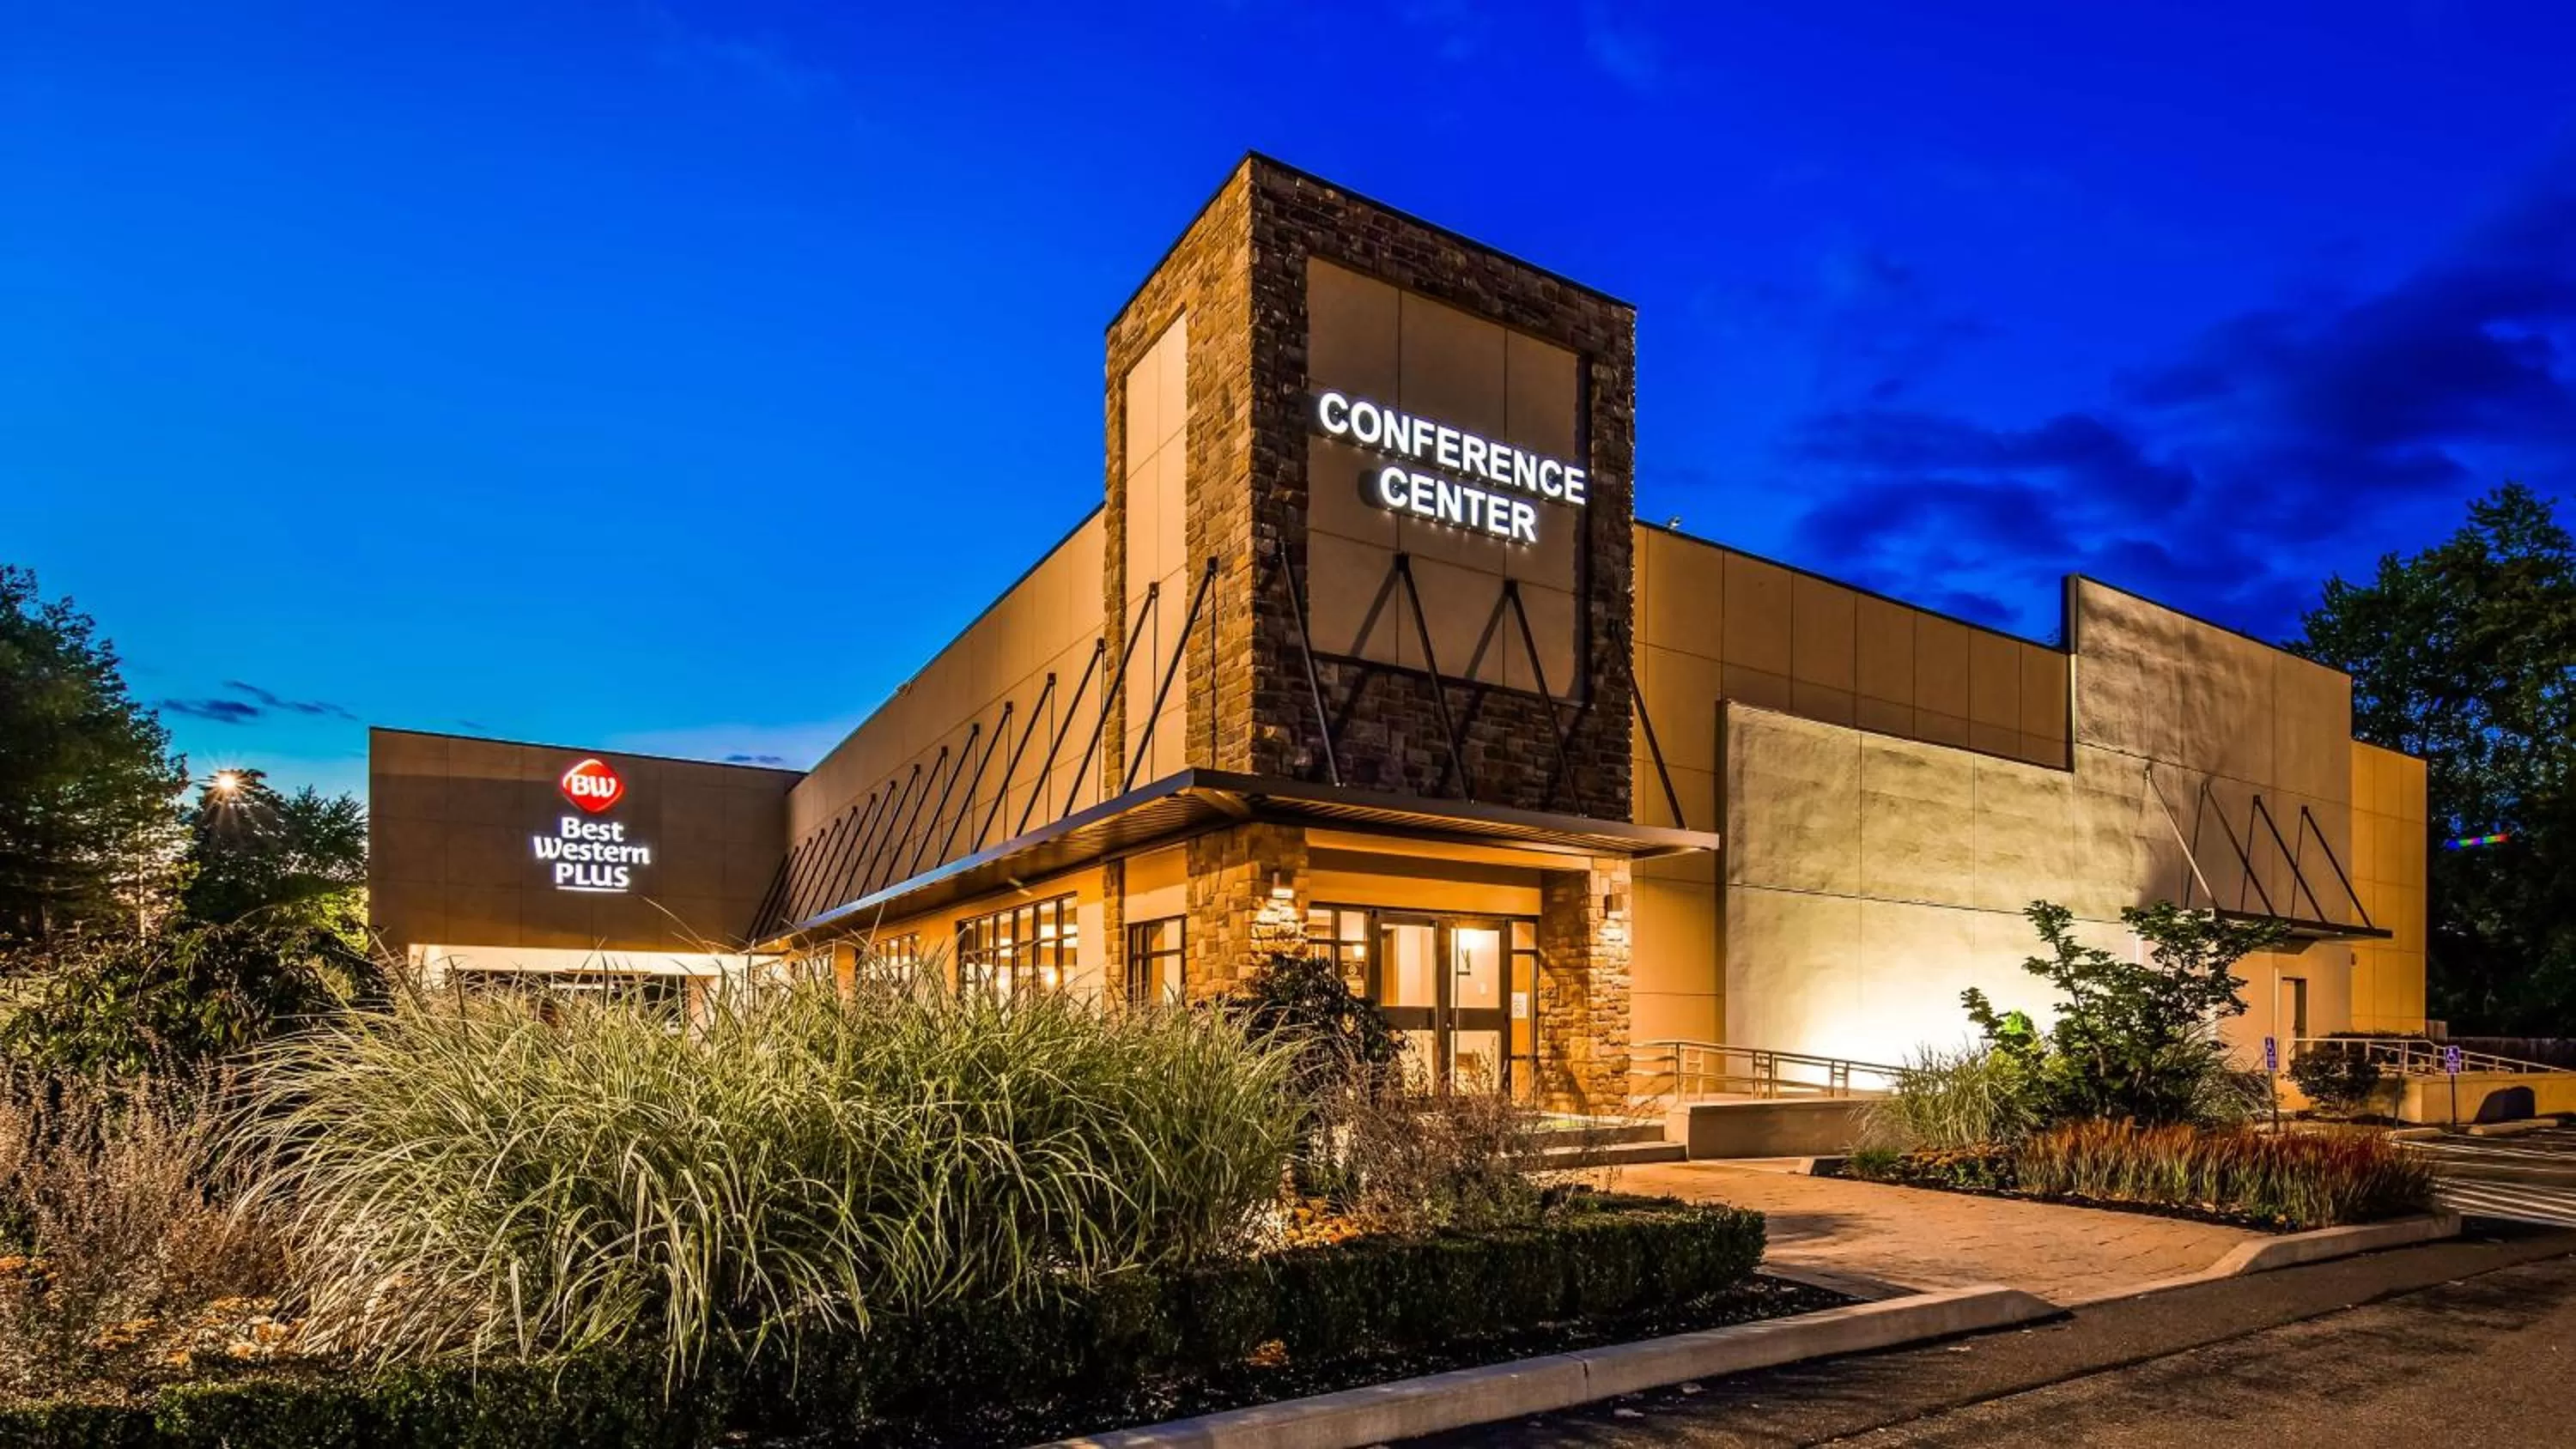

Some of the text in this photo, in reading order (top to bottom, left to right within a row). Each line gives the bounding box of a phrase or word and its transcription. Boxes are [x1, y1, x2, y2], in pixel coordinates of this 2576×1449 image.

[1318, 392, 1586, 506] CONFERENCE
[1379, 466, 1537, 543] CENTER
[571, 774, 617, 797] BW
[560, 816, 625, 842] Best
[532, 835, 651, 864] Western
[555, 862, 630, 888] PLUS
